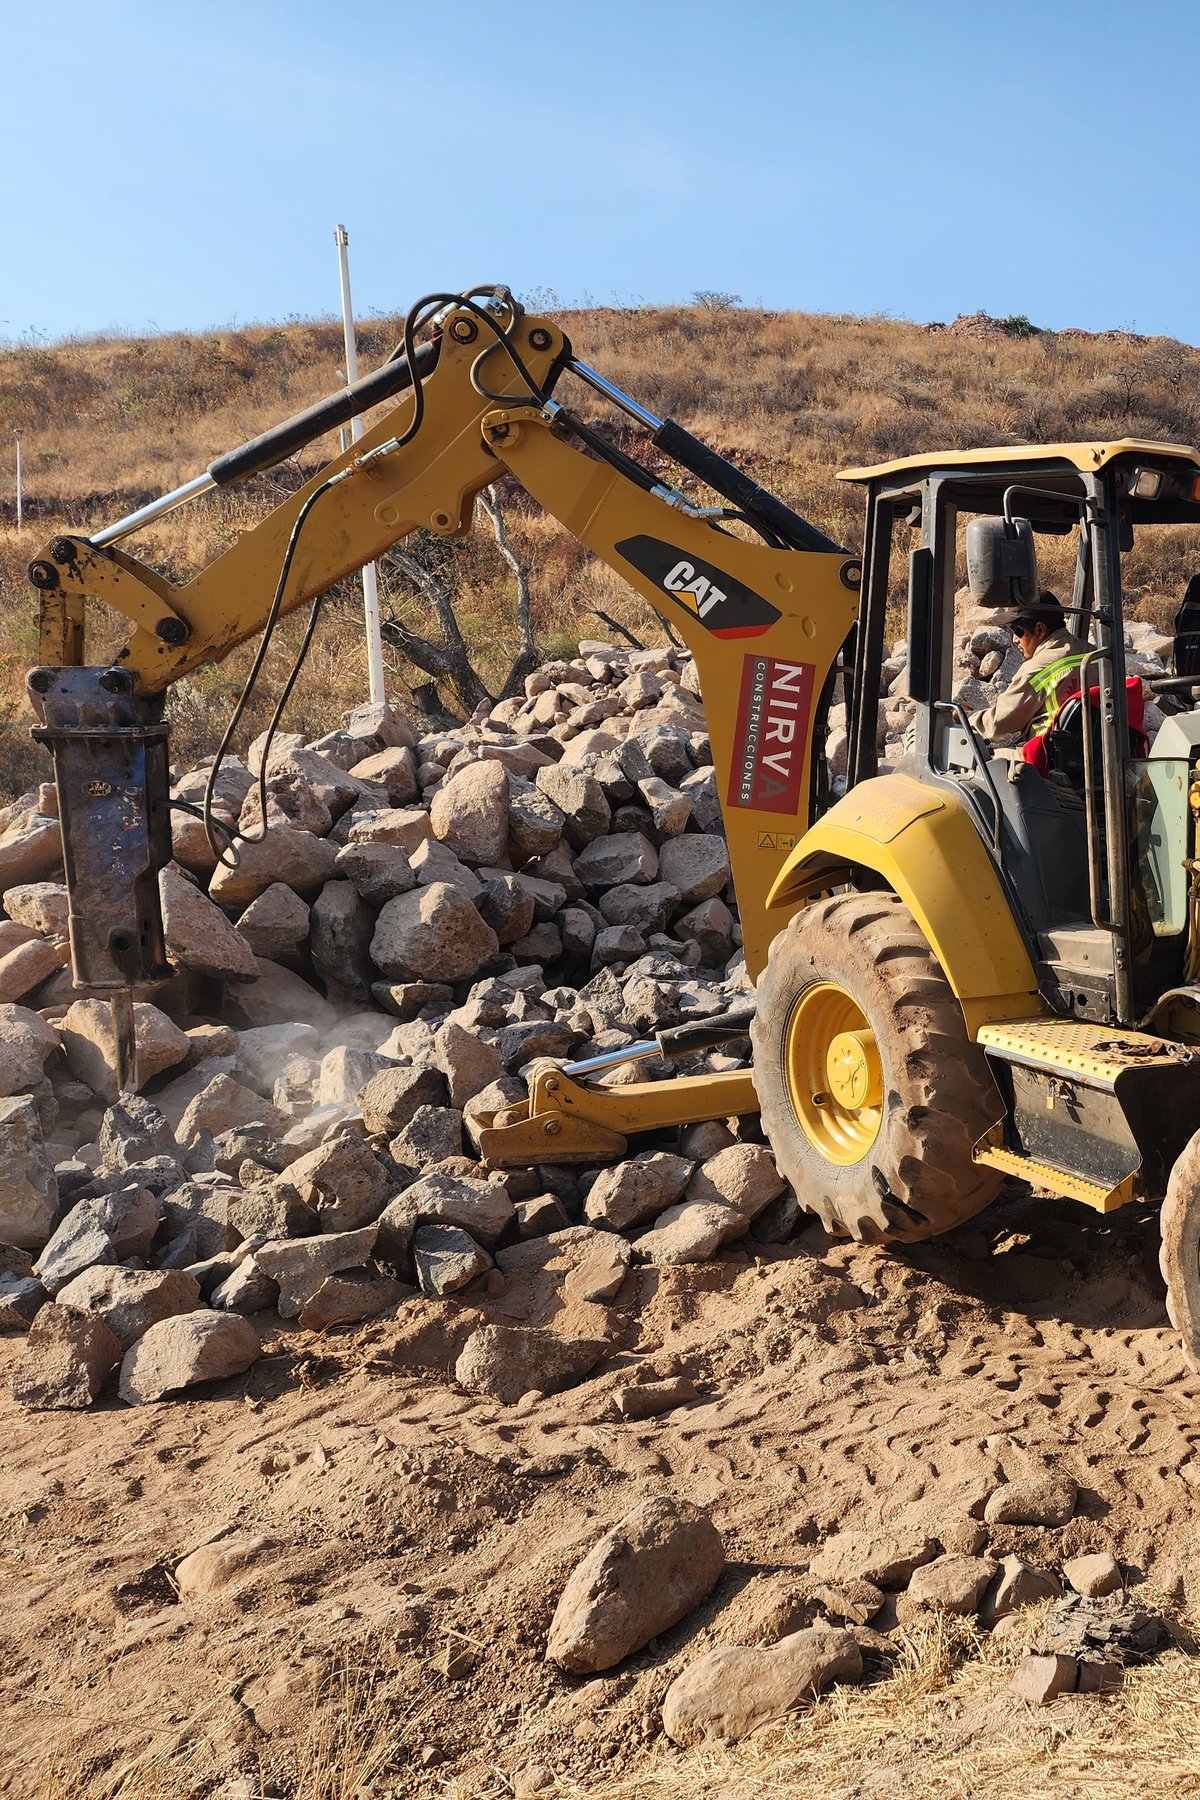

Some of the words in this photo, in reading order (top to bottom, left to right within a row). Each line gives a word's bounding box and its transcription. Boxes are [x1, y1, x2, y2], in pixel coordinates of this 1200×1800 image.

[663, 561, 727, 618] CAT
[740, 662, 766, 802] CONSTRUCCIONES
[761, 662, 802, 798] NIRVA
